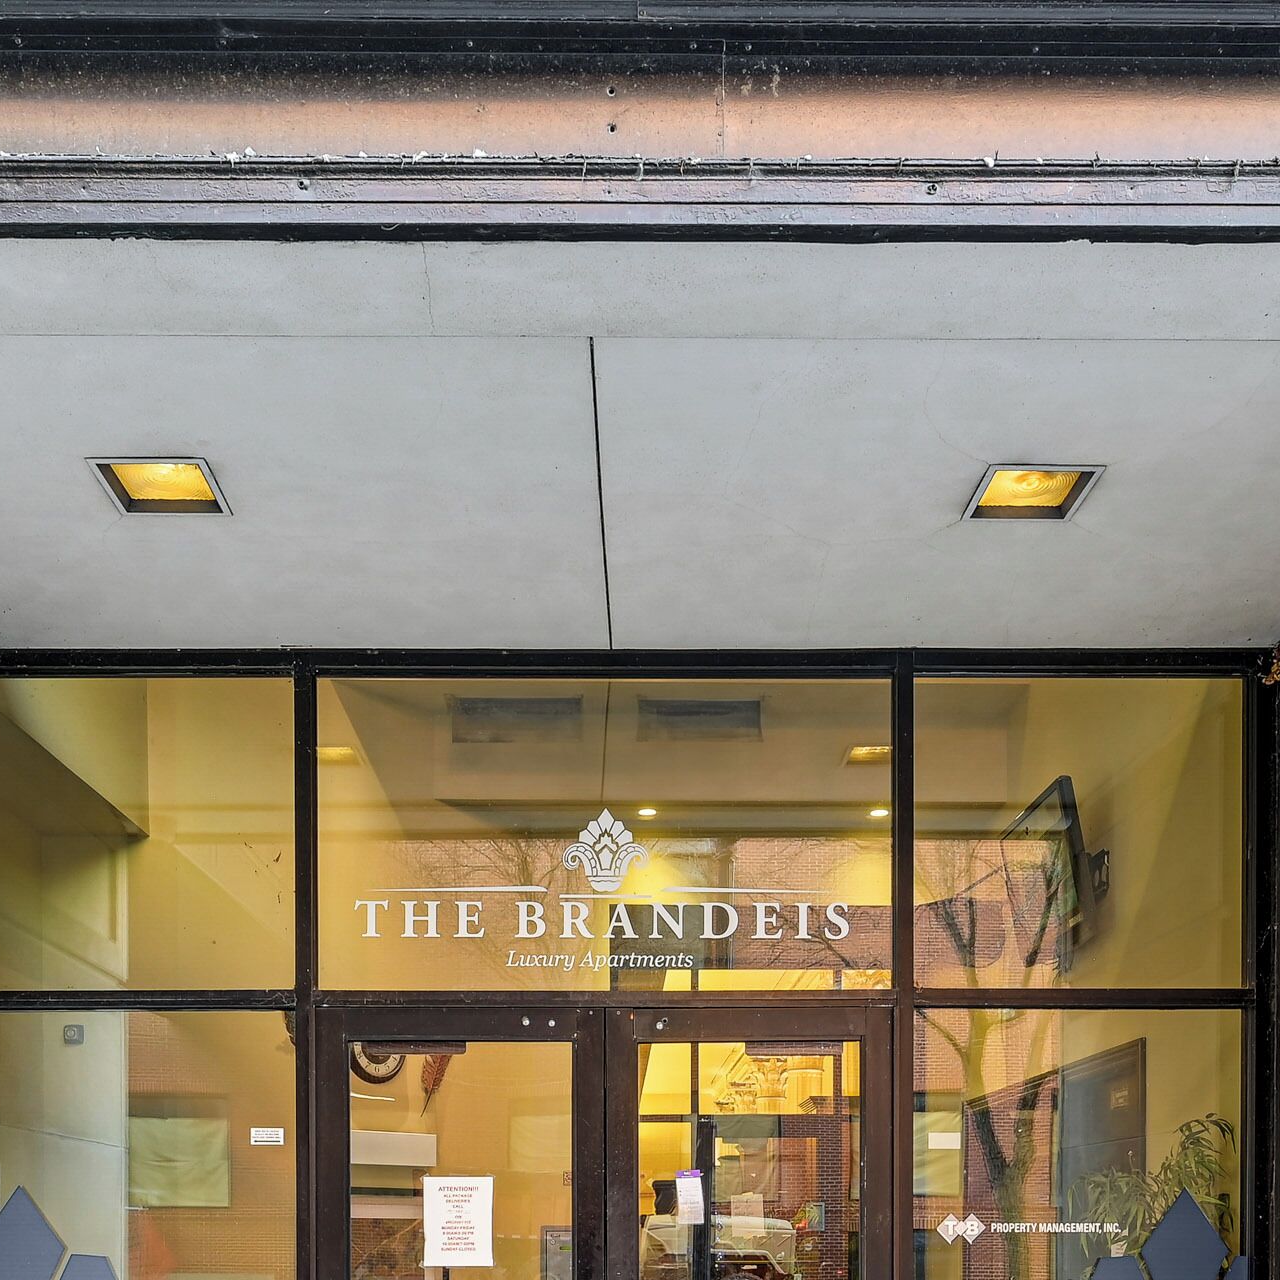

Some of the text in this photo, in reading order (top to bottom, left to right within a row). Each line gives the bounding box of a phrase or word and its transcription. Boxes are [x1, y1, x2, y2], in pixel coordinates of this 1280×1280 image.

[353, 899, 851, 940] THE BRANDEIS
[506, 950, 694, 972] Luxury Apartments
[990, 1222, 1121, 1234] PROPERTY MANAGEMENT, INC.
